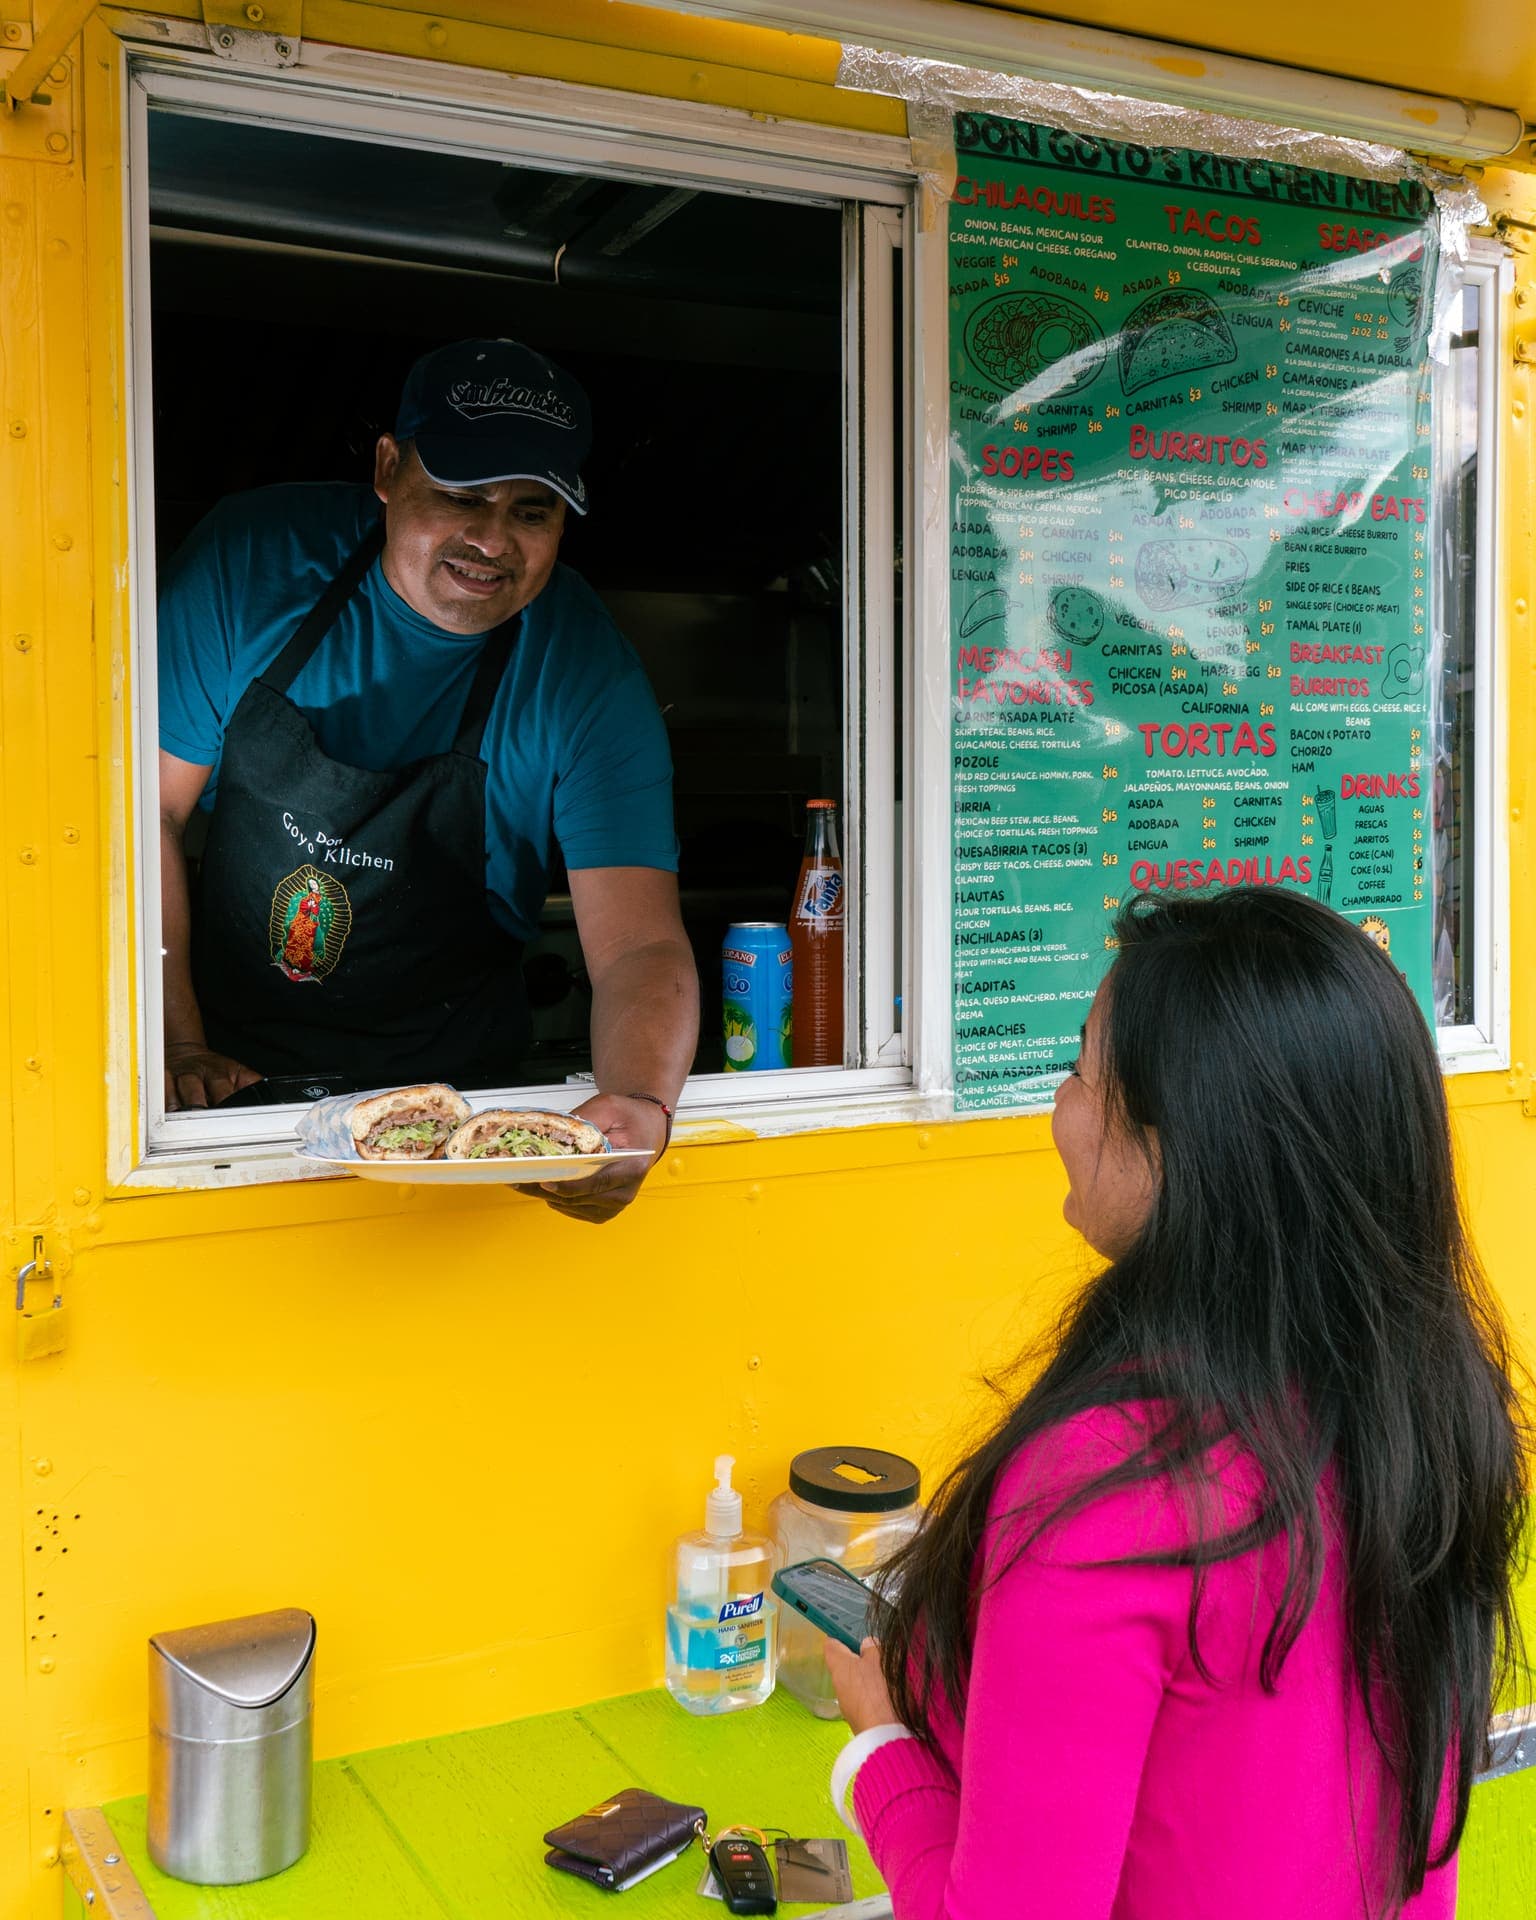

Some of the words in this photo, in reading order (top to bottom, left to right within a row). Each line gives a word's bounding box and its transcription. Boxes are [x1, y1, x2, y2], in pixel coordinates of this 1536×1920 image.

[955, 112, 1040, 159] DON
[952, 175, 1117, 223] CHILAQUILES
[964, 219, 999, 232] ONION,
[1001, 222, 1034, 236] BEANS,
[1036, 227, 1079, 241] MEXICAN
[1080, 234, 1104, 245] SOUR
[1163, 205, 1262, 246] TACOS
[949, 233, 987, 245] CREAM,
[989, 237, 1034, 251] MEXICAN
[1074, 248, 1117, 261] OREGANO
[954, 256, 996, 269] VEGGIE
[1002, 254, 1019, 269] $14
[1237, 254, 1259, 265] CHILE
[1260, 258, 1297, 270] SERRANO
[950, 278, 990, 296] ASADA
[994, 272, 1010, 288] $15
[1029, 265, 1087, 294] ADOBADA
[1093, 285, 1110, 303] $13
[1122, 275, 1162, 296] ASADA
[1168, 269, 1181, 286] $3
[1217, 279, 1273, 302] ADOBADA
[1298, 299, 1345, 318] CEVICHE
[1231, 312, 1273, 329] LENGUA
[1279, 316, 1292, 334] $4
[1285, 342, 1350, 361] CAMARONES
[1362, 352, 1375, 363] LA
[1378, 354, 1414, 369] DIABLA
[1211, 370, 1259, 394] CHICKEN
[1266, 363, 1278, 380] $3
[1125, 392, 1184, 416] CARNITAS
[1189, 386, 1202, 403] $3
[1222, 400, 1262, 414] SHRIMP
[1266, 400, 1279, 416] $4
[1037, 403, 1094, 417] CARNITAS
[1105, 404, 1120, 419] $14
[1036, 422, 1078, 438] SHRIMP
[1088, 420, 1103, 435] $16
[1129, 423, 1268, 469] BURRITOS
[981, 444, 1074, 481] SOPES
[1164, 488, 1187, 499] PICO
[1189, 490, 1201, 500] DE
[1203, 491, 1233, 503] GALLO
[1371, 494, 1426, 524] EATS
[952, 522, 991, 535] ASADA
[952, 546, 1008, 561] ADOBADA
[1284, 542, 1307, 553] BEAN
[1314, 545, 1332, 554] RICE
[1334, 544, 1367, 556] BURRITO
[952, 568, 996, 582] LENGUA
[1285, 562, 1310, 574] FRIES
[1285, 581, 1305, 593] SIDE
[1308, 583, 1320, 593] OF
[1322, 583, 1342, 595] RICE
[1286, 601, 1312, 611] SINGLE
[1313, 601, 1332, 611] SOPE
[1333, 602, 1364, 613] (CHOICE
[1376, 604, 1400, 615] MEAT)
[1286, 620, 1319, 632] TAMAL
[1322, 621, 1350, 633] PLATE
[1101, 644, 1162, 657] CARNITAS
[1171, 642, 1187, 657] $14
[1290, 641, 1385, 664] BREAKFAST
[957, 644, 1073, 674] MEXICAN
[1108, 666, 1161, 680] CHICKEN
[1171, 665, 1187, 681] $14
[957, 677, 1094, 707] FAVORITES
[1112, 682, 1156, 696] PICOSA
[1159, 682, 1208, 697] (ASADA)
[1222, 681, 1238, 696] $16
[1290, 674, 1370, 697] BURRITOS
[1181, 701, 1249, 715] CALIFORNIA
[1260, 702, 1274, 717] $19
[1290, 703, 1304, 713] ALL
[1305, 703, 1328, 713] COME
[1330, 703, 1349, 713] WITH
[1403, 703, 1421, 713] RICE
[954, 711, 996, 723] CARNE
[999, 711, 1038, 723] ASADA
[1040, 711, 1075, 723] PLATE
[1345, 717, 1371, 727] BEANS
[1138, 721, 1278, 758] TORTAS
[1290, 729, 1325, 741] BACON
[1332, 729, 1371, 740] POTATO
[1410, 727, 1421, 741] $9
[1041, 740, 1081, 749] TORTILLAS
[1290, 746, 1332, 757] CHORIZO
[1410, 743, 1421, 756] $8
[954, 756, 999, 769] POZOLE
[1102, 764, 1118, 781] $16
[1291, 762, 1315, 773] HAM
[954, 785, 977, 793] FRESH
[979, 784, 1016, 793] TOPPINGS
[1264, 781, 1289, 791] ONION
[1340, 773, 1421, 800] DRINKS
[1128, 799, 1164, 809] ASADA
[1202, 796, 1216, 810] $15
[1233, 796, 1283, 808] CARNITAS
[1301, 794, 1315, 808] $14
[1358, 804, 1385, 814] AGUAS
[954, 801, 991, 814] BIRRIA
[1102, 807, 1118, 824] $15
[1128, 819, 1179, 830] ADOBADA
[1202, 817, 1216, 830] $14
[1233, 816, 1276, 828] CHICKEN
[1354, 820, 1388, 830] FRESCAS
[283, 812, 314, 854] Goyo
[1353, 834, 1390, 845] JARRITOS
[954, 845, 1028, 859] QUESABIRRIA
[1031, 843, 1071, 856] TACOS
[1073, 841, 1088, 857] (3)
[1128, 840, 1168, 851] LENGUA
[1202, 837, 1216, 851] $16
[1233, 836, 1270, 848] SHRIMP
[1349, 850, 1371, 861] COKE
[1371, 849, 1395, 861] (CAN)
[1129, 855, 1313, 892] QUESADILLAS
[1350, 865, 1371, 876] COKE
[1358, 880, 1386, 891] COFFEE
[804, 873, 842, 917] Fanta
[954, 890, 1005, 904] FLAUTAS
[1341, 894, 1402, 907] CHAMPURRADO
[954, 930, 1026, 946] ENCHILADAS
[954, 979, 1016, 995] PICADITAS
[955, 1023, 1026, 1040] HUARACHES
[1019, 1050, 1054, 1061] LETTUCE
[724, 1597, 760, 1618] Purell
[718, 1624, 736, 1633] HAND
[737, 1618, 763, 1630] SANITIZER
